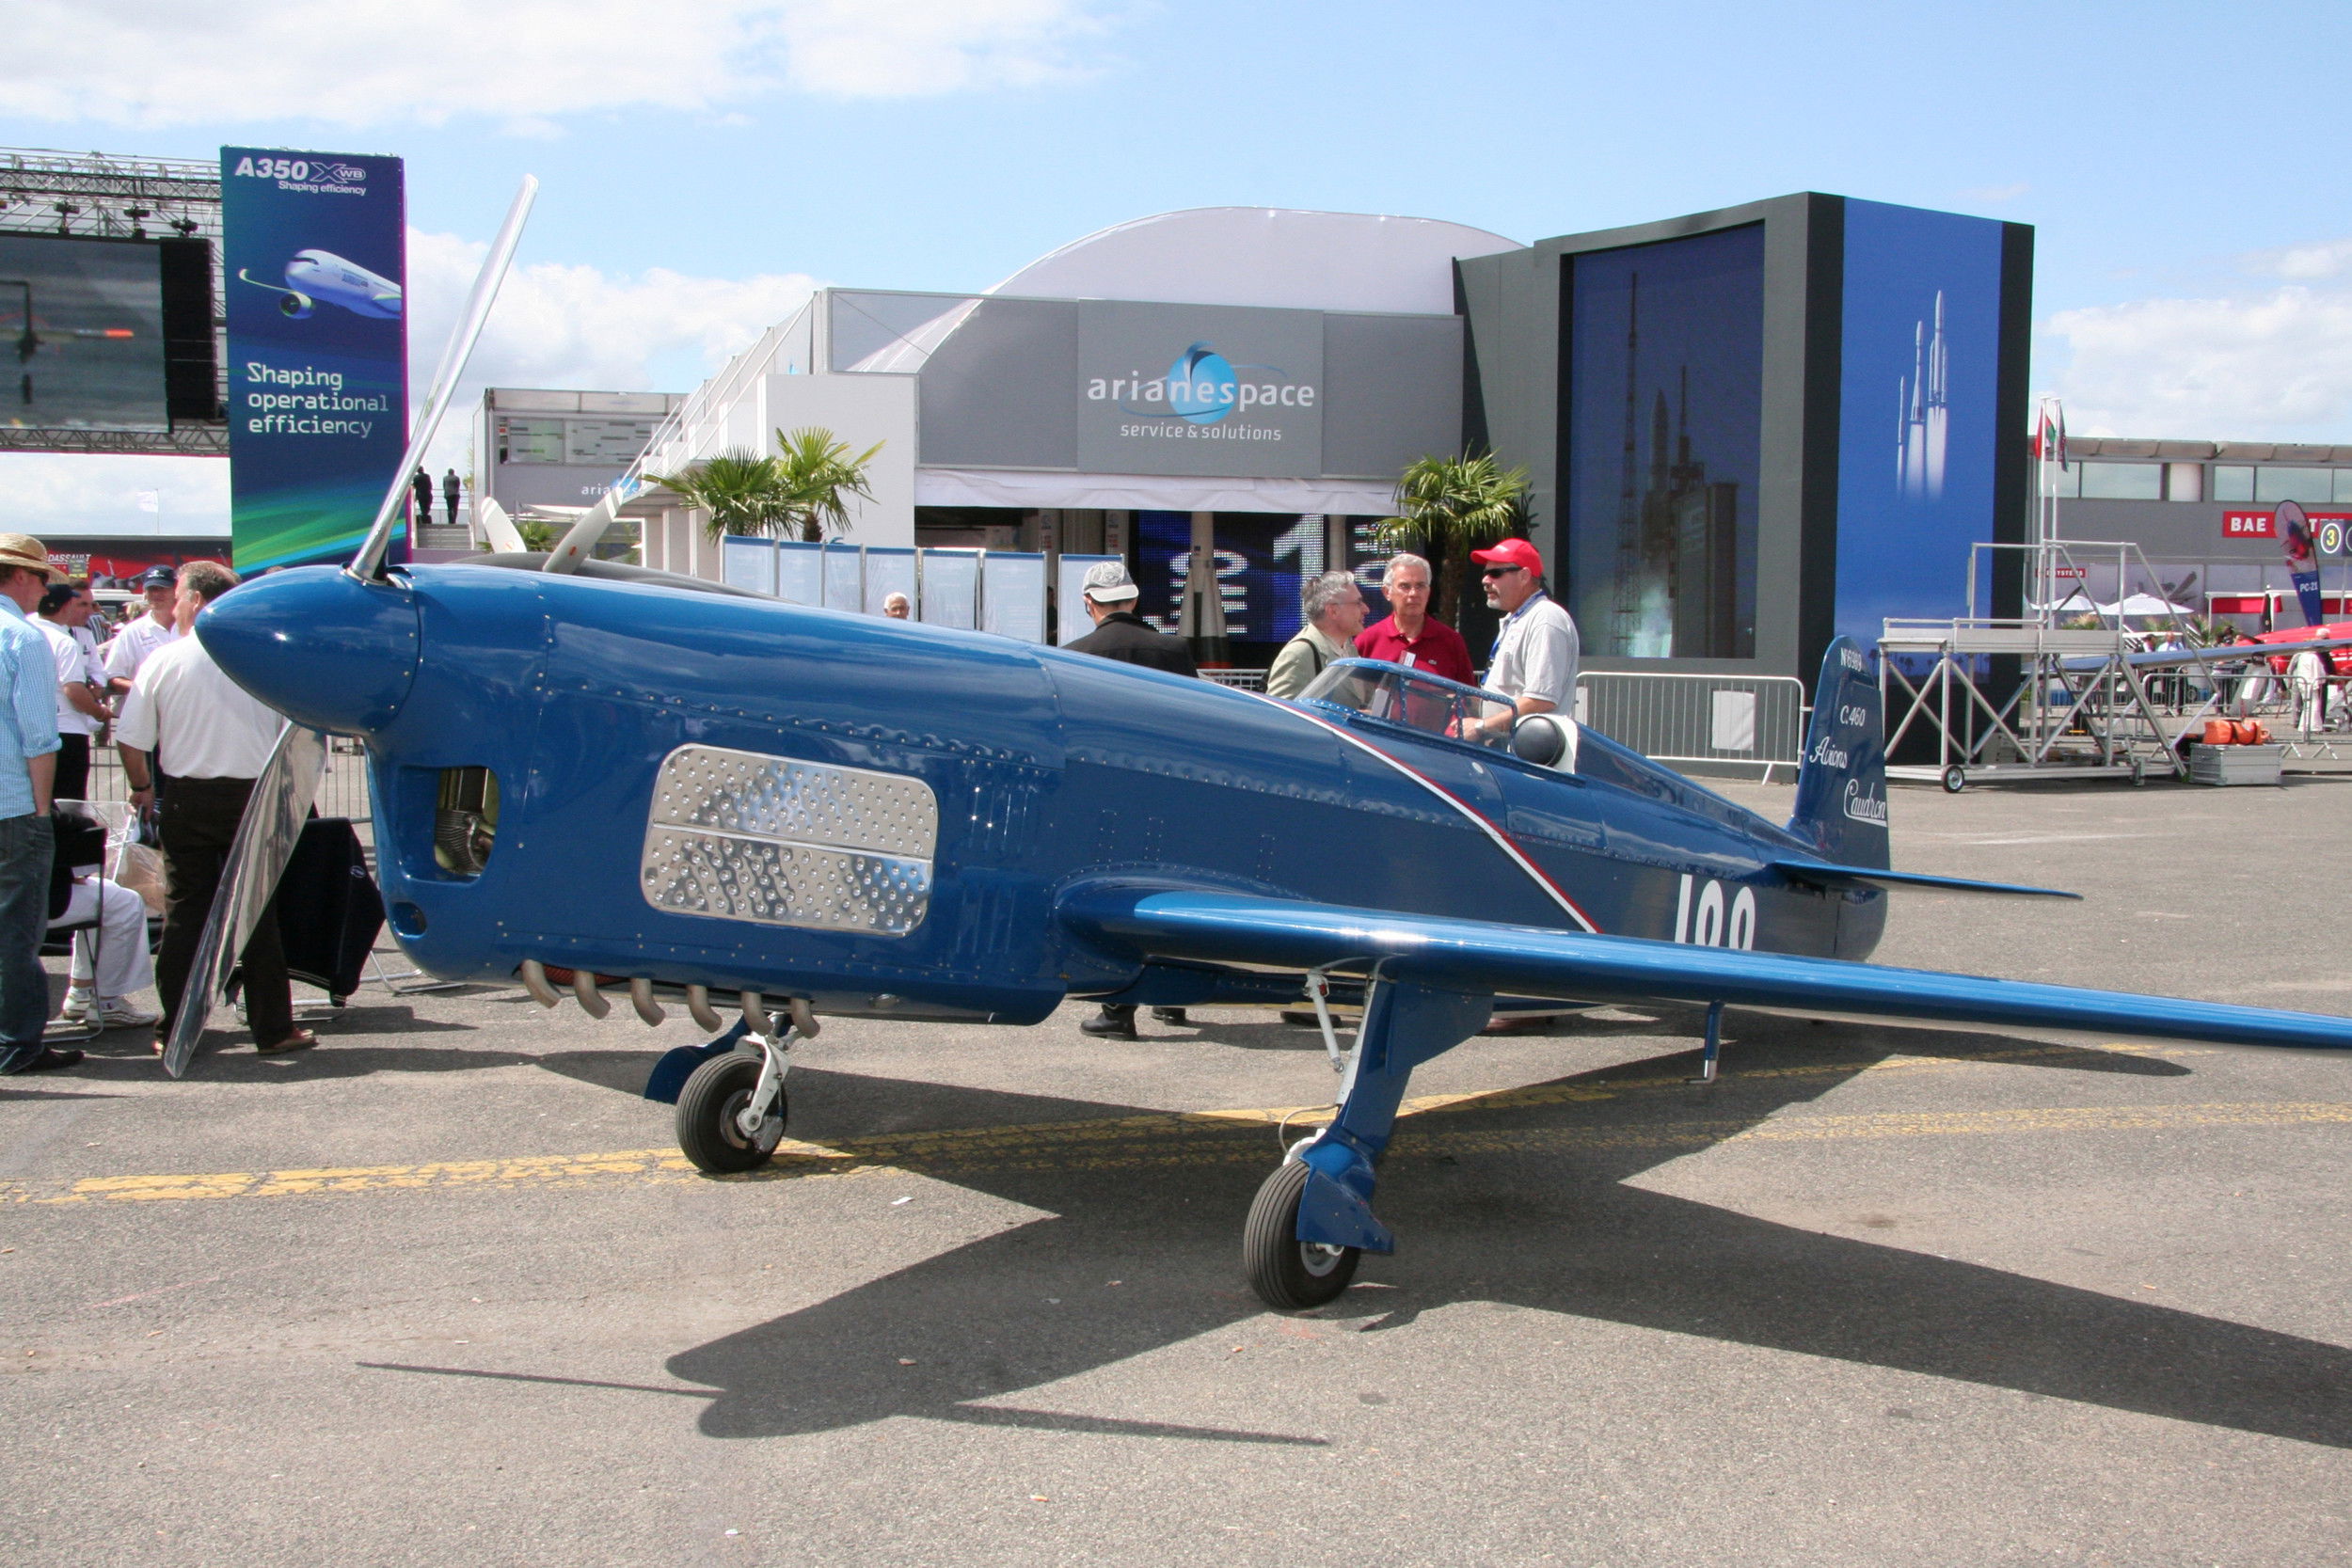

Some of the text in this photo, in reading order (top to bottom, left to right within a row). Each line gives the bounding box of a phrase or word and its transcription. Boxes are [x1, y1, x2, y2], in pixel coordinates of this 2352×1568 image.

[235, 157, 309, 181] A350
[278, 181, 366, 196] Shaping efficiency
[246, 362, 342, 390] Shaping
[248, 391, 389, 412] operational
[1087, 370, 1315, 412] arianespace
[248, 414, 373, 438] efficiency
[1120, 422, 1282, 440] service & solutions
[2230, 517, 2266, 532] BAE
[2326, 529, 2335, 546] 3
[1809, 736, 1848, 769] Avions
[1843, 779, 1887, 826] Caudron
[1675, 873, 1756, 951] 100
